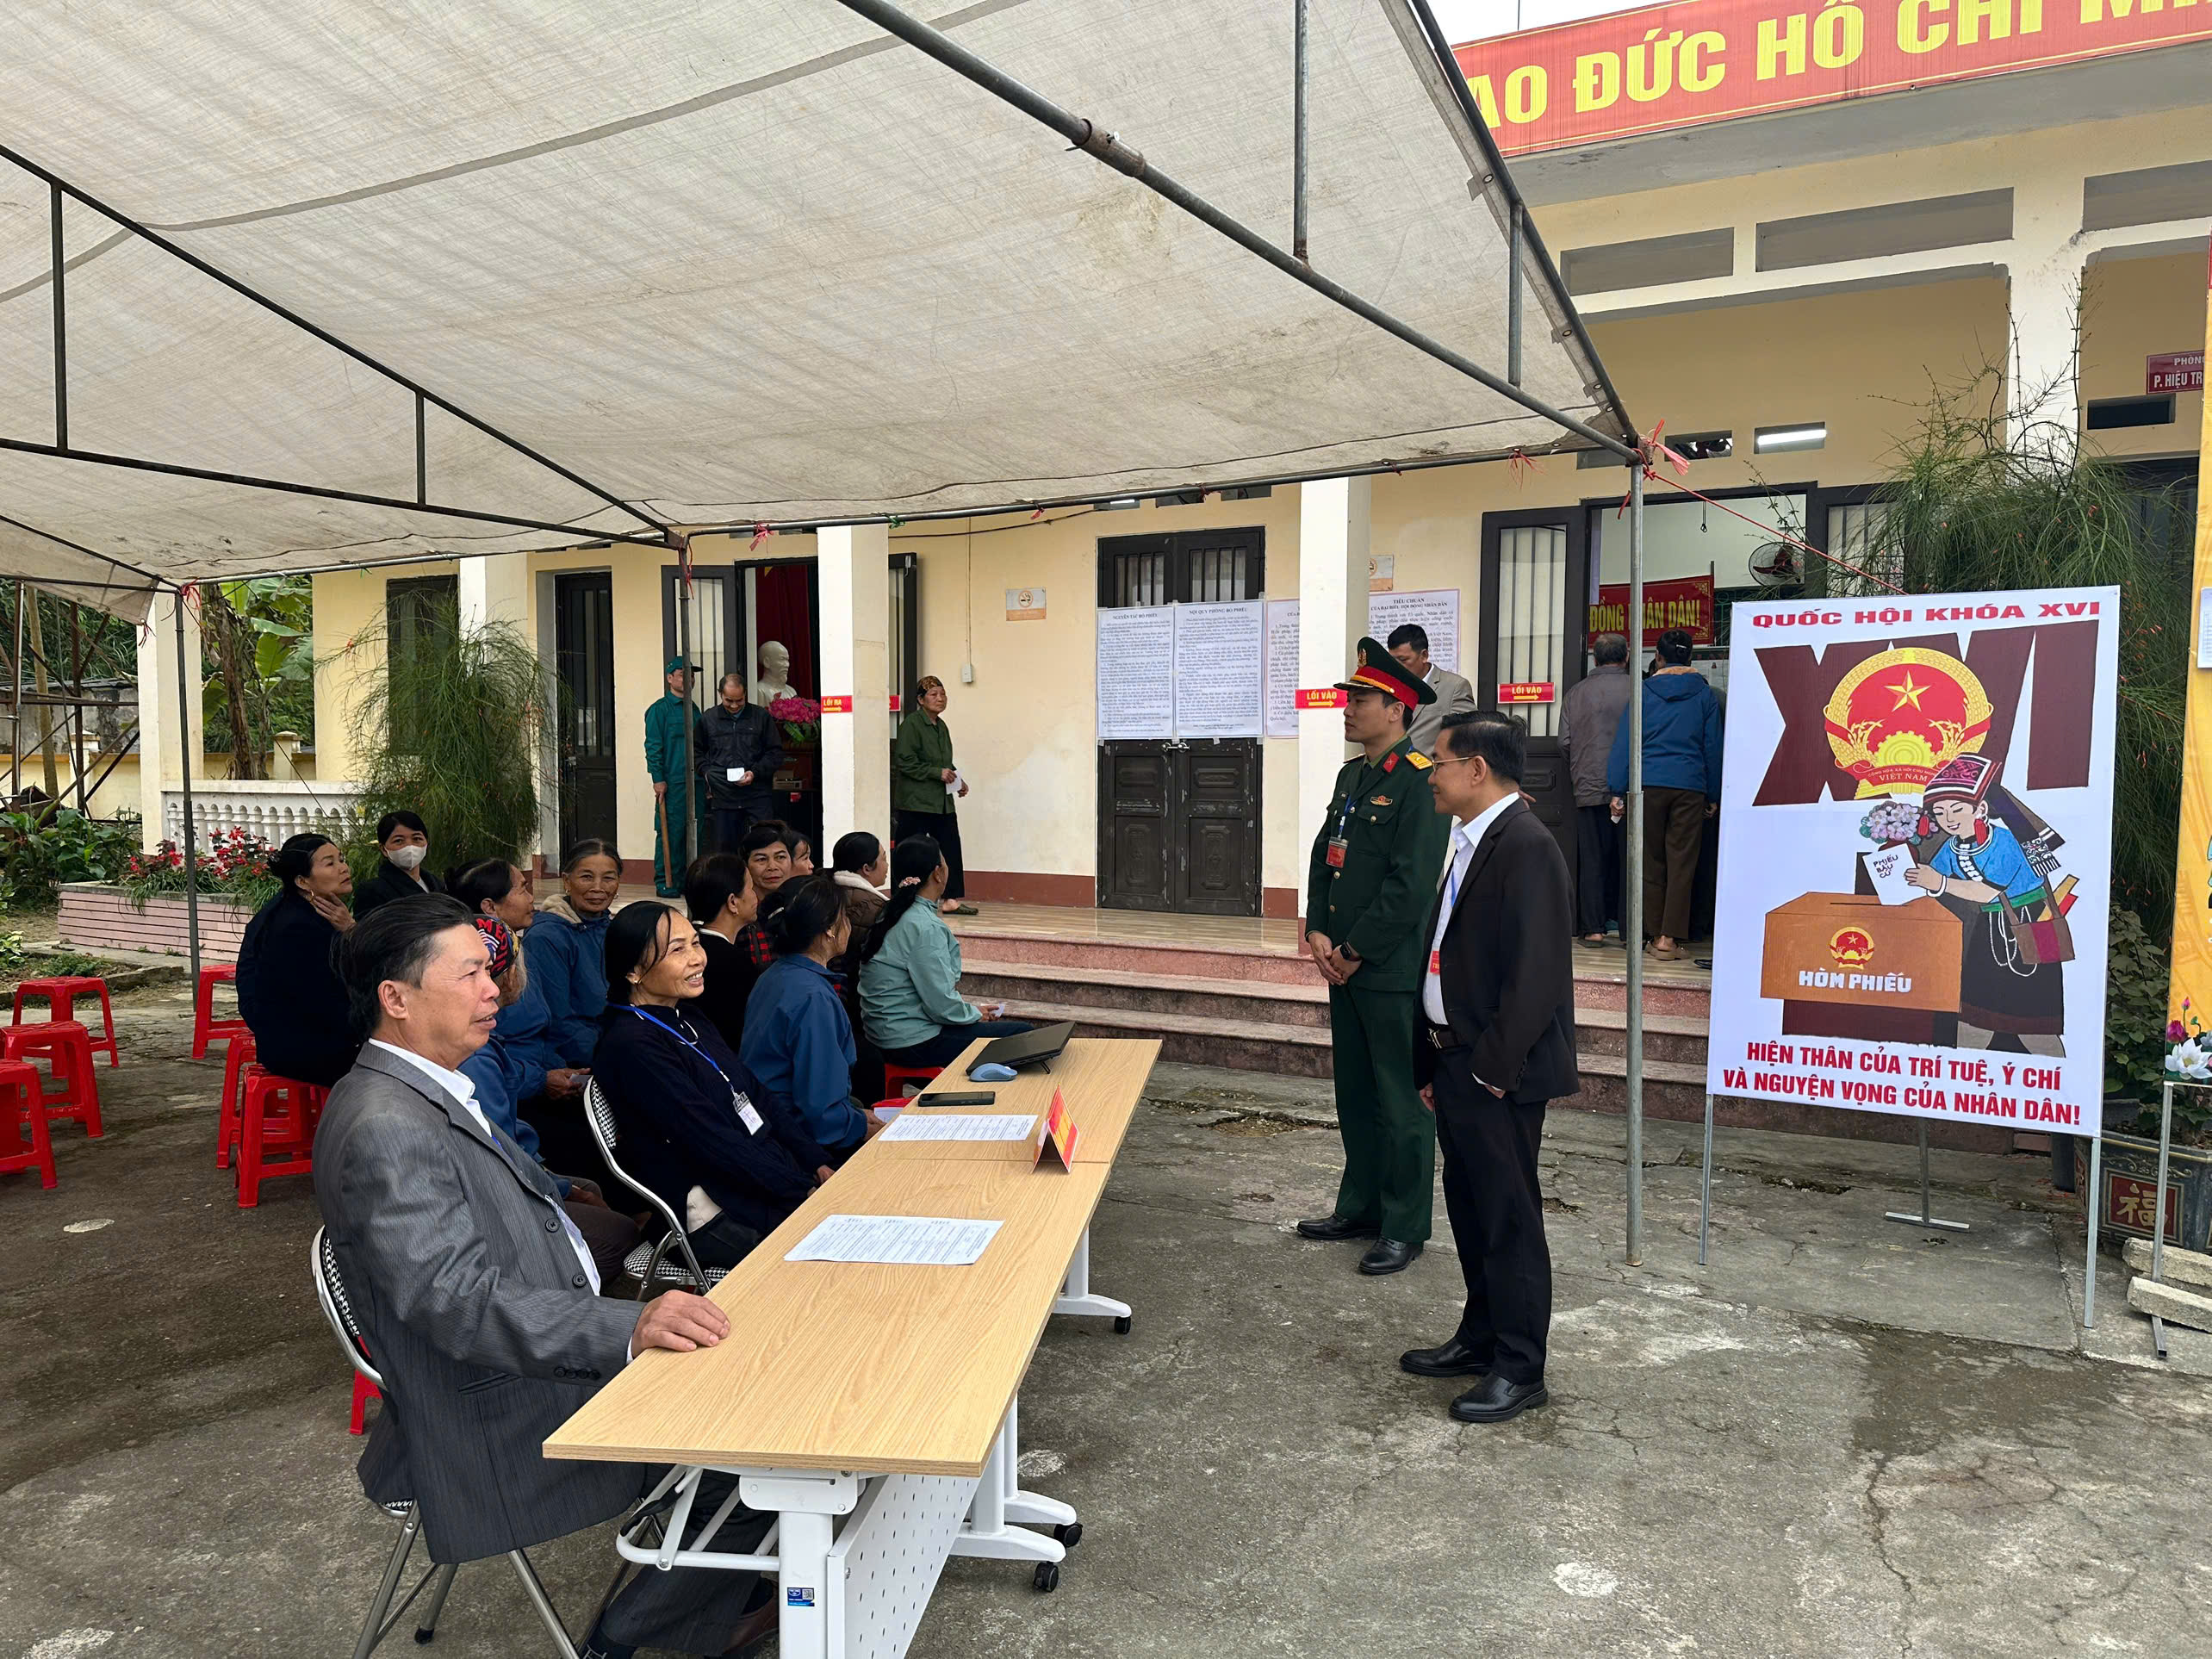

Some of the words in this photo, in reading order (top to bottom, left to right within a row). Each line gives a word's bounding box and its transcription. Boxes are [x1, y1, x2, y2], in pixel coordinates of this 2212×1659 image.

[1572, 28, 1726, 113] ĐỨC
[2154, 375, 2163, 388] P.
[2165, 370, 2188, 388] HIỆU
[1668, 594, 1700, 628] DÂN!
[1752, 608, 1842, 629] QUỐC
[1855, 607, 1912, 626] HỘI
[1925, 603, 2025, 621] KHÓA
[2038, 601, 2100, 618] XVI
[1307, 690, 1320, 699] LỐI
[1321, 691, 1337, 699] VÀO
[1512, 685, 1525, 694] LỐI
[1526, 686, 1542, 694] VÀO
[1904, 773, 1928, 782] NAM
[1873, 854, 1898, 867] PHIẾU
[1799, 967, 1845, 989] HÒM
[1849, 972, 1912, 992] PHIẾU
[1747, 1040, 1793, 1066] HIỆN
[1800, 1045, 1853, 1070] THÂN
[1860, 1046, 1902, 1074] CỦA
[1908, 1055, 1942, 1078] TRÍ
[1948, 1059, 1994, 1087] TUỆ,
[2002, 1061, 2016, 1085] Ý
[2022, 1066, 2061, 1090] CHÍ
[1723, 1066, 1748, 1090] VÀ
[1754, 1072, 1835, 1101] NGUYỆN
[1841, 1080, 1897, 1106] VỌNG
[1904, 1080, 1947, 1110] CỦA
[1954, 1092, 2016, 1118] NHÂN
[2024, 1097, 2080, 1125] DÂN!
[2116, 1183, 2169, 1227] 福
